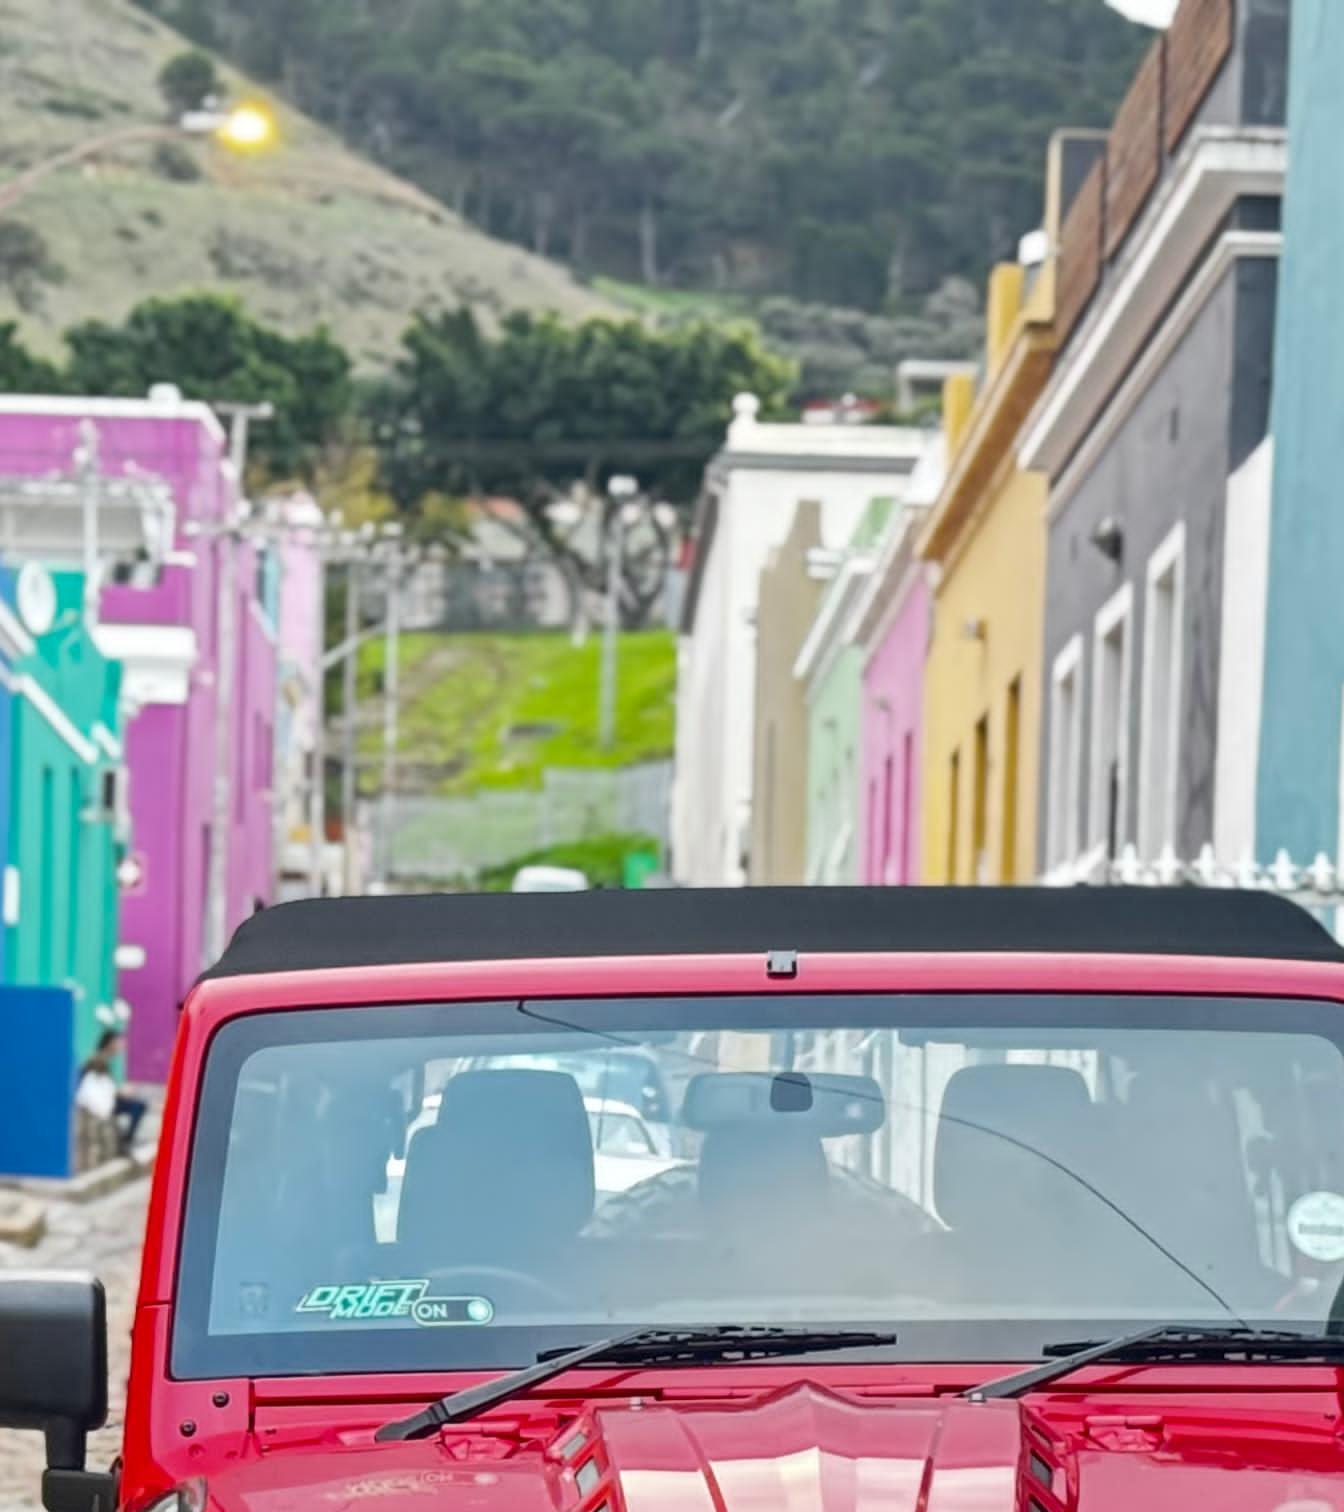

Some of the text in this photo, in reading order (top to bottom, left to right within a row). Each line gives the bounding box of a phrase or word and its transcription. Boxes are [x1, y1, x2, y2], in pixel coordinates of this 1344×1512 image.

[306, 1283, 423, 1307] DRIFT
[329, 1300, 414, 1319] MODE
[417, 1303, 448, 1319] ON
